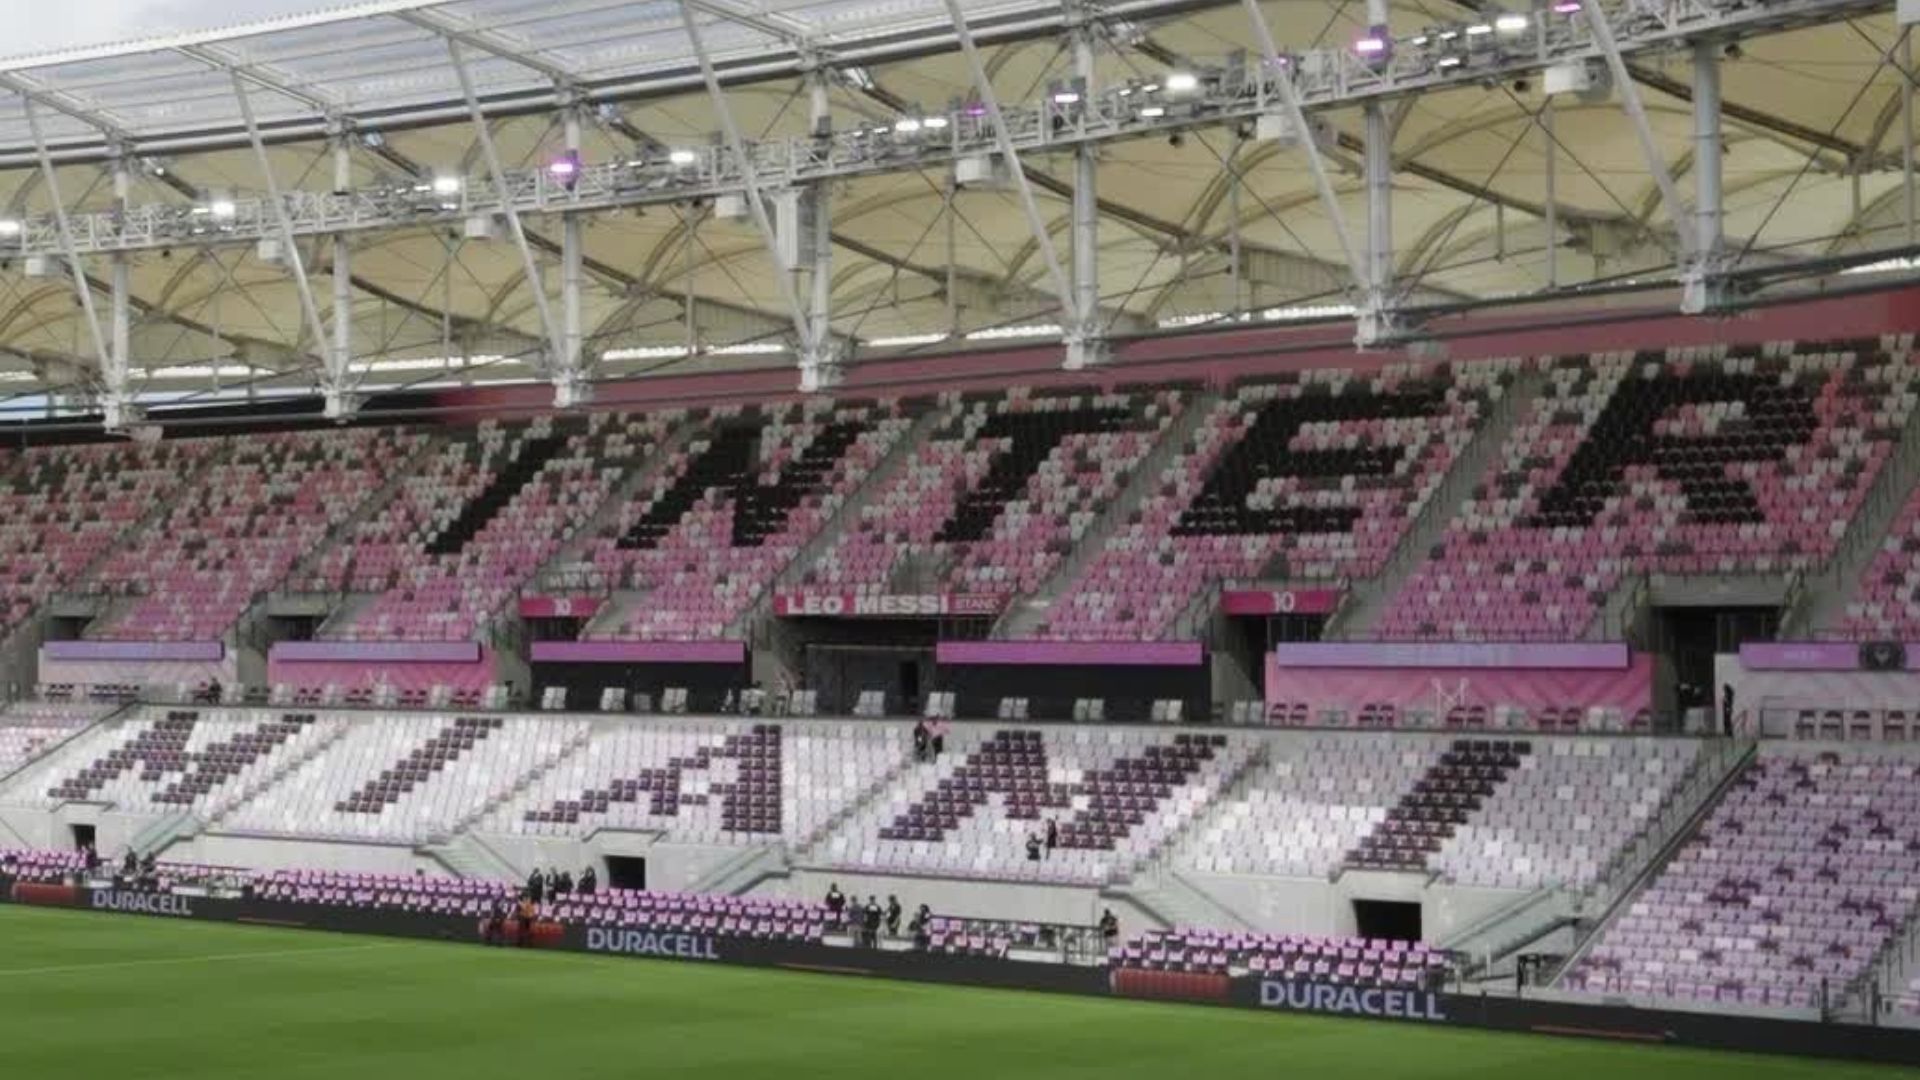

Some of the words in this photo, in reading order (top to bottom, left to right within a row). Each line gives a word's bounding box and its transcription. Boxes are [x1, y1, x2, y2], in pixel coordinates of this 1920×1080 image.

[425, 362, 1818, 553] INTER
[553, 598, 573, 616] 10
[787, 596, 843, 615] LEO
[854, 594, 948, 615] MESSI
[1272, 591, 1296, 614] 10
[47, 711, 1532, 868] MIAMI
[93, 889, 193, 916] DURACELL
[587, 927, 720, 959] DURACELL
[1260, 980, 1447, 1020] DURACELL
